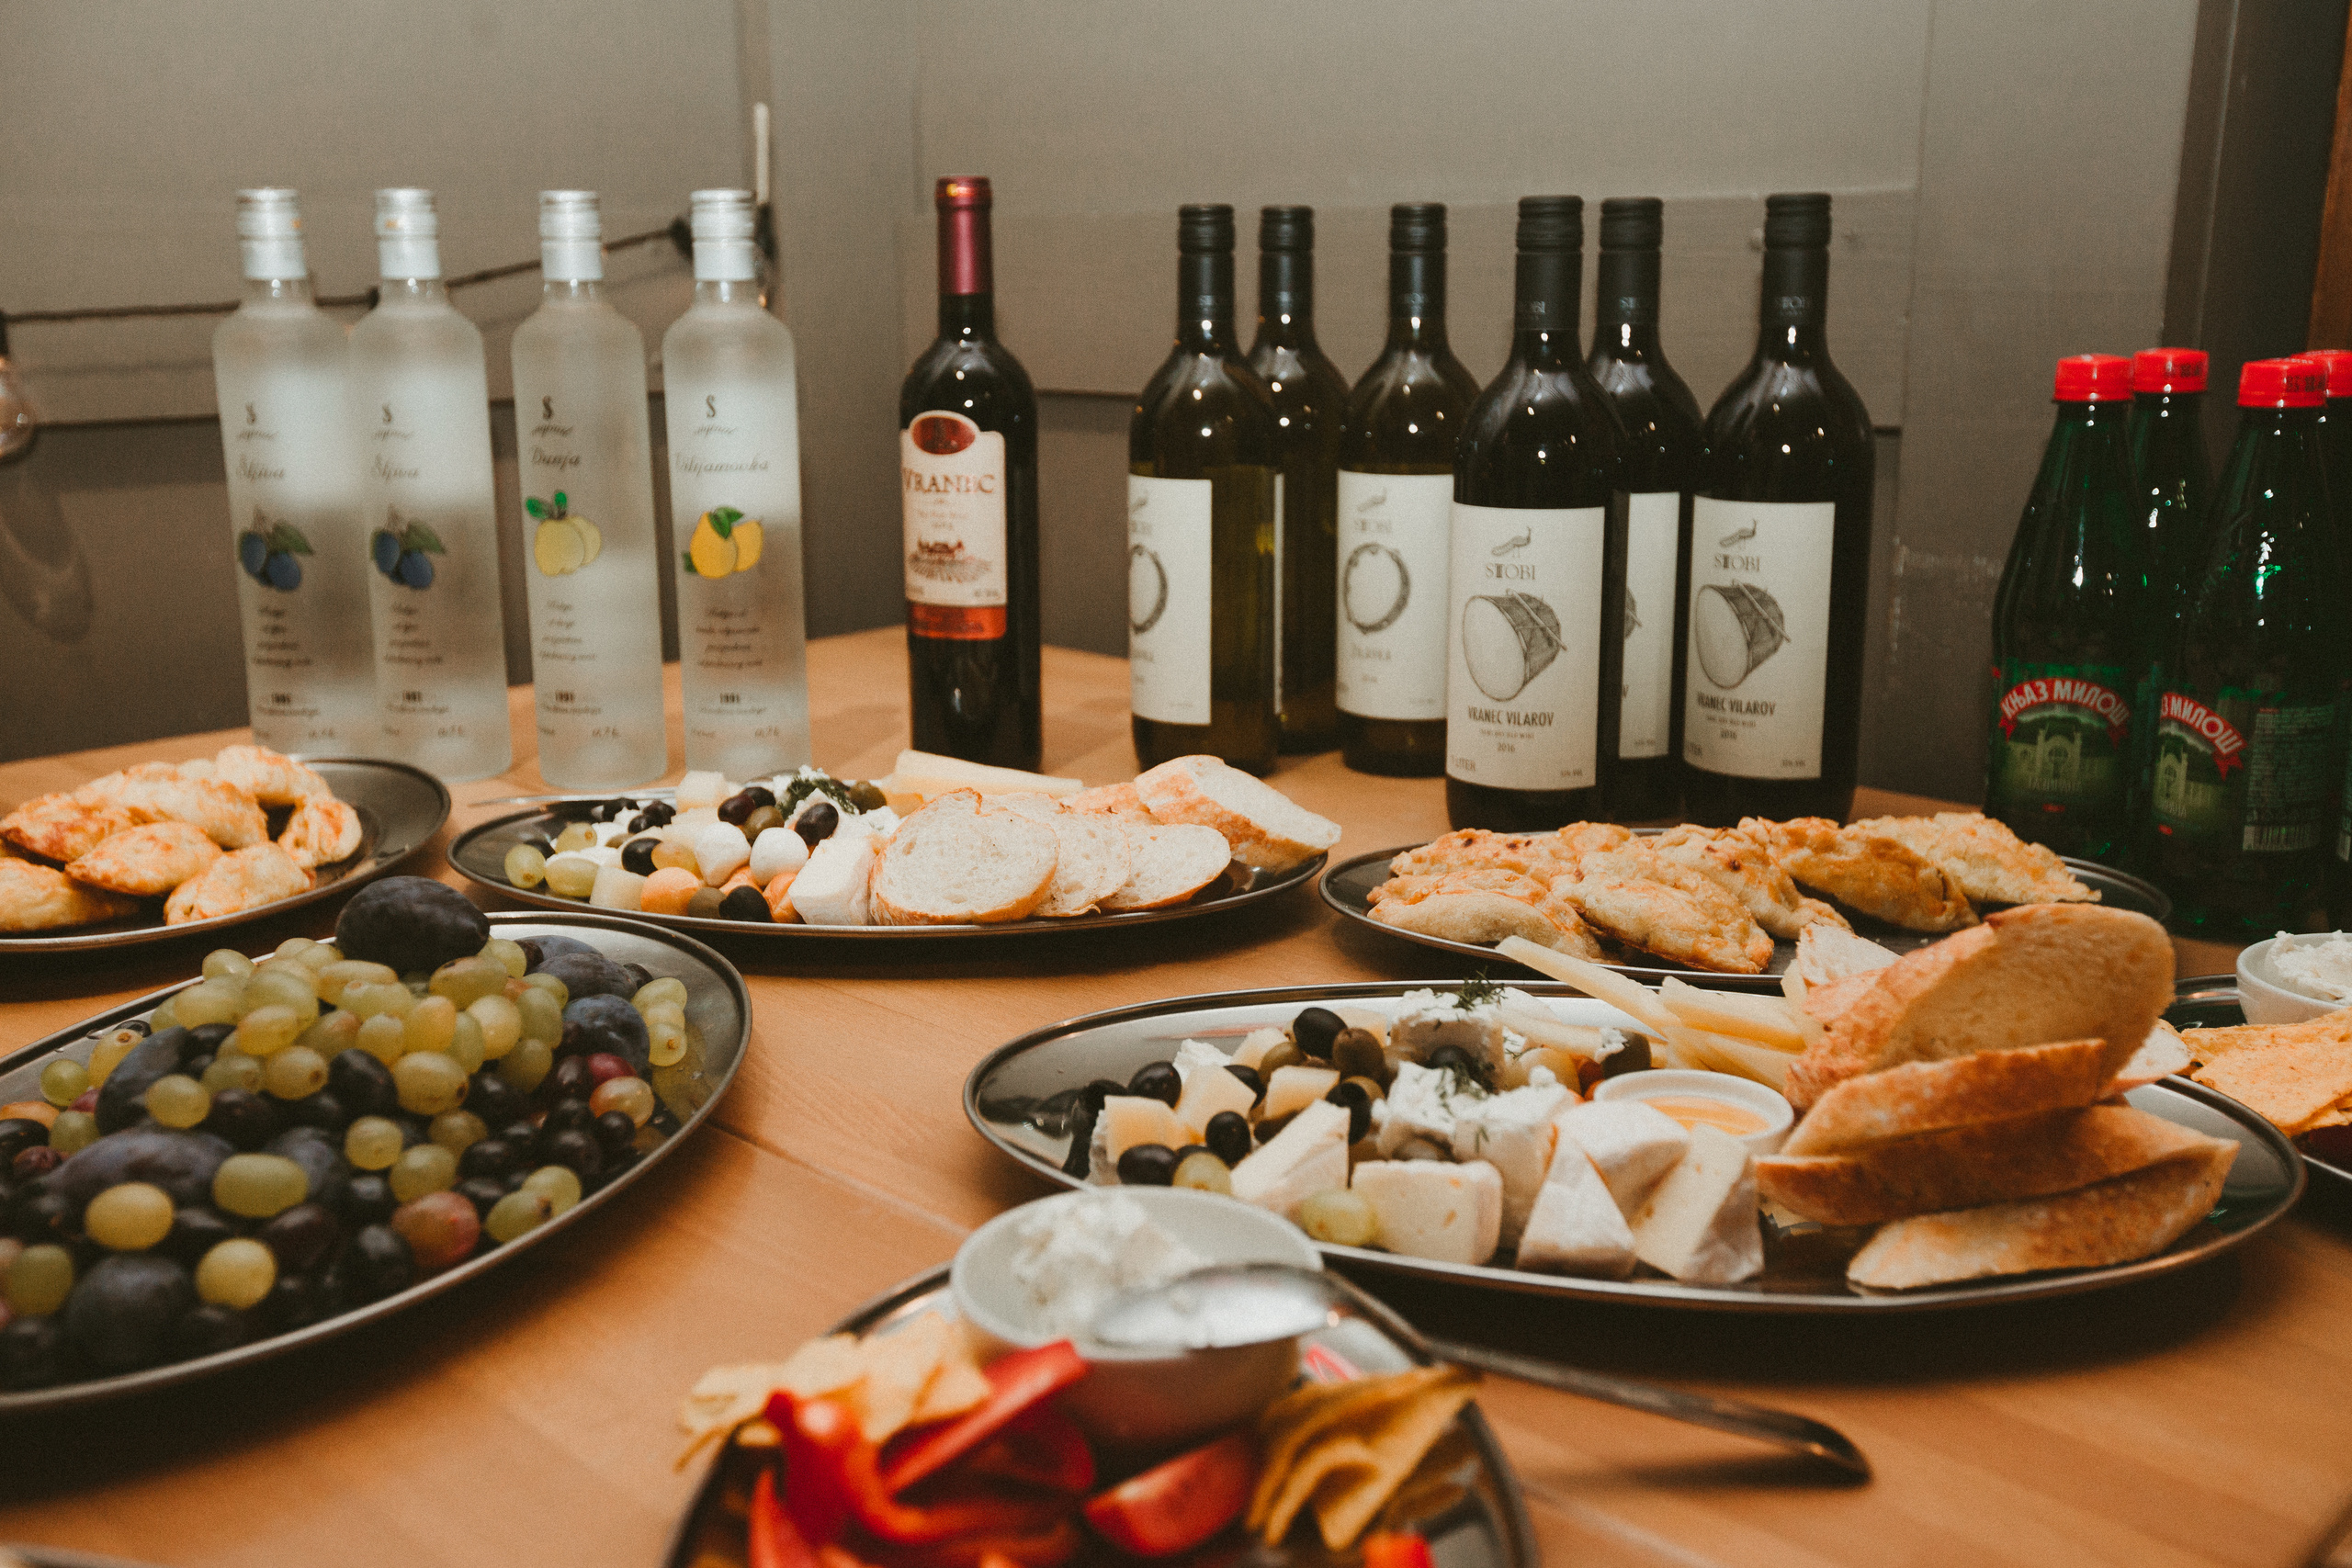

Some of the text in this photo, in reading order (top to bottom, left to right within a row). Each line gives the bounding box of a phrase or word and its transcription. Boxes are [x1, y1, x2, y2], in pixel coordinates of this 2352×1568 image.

[706, 395, 717, 419] S
[1485, 562, 1536, 581] STOBI
[1713, 553, 1762, 573] STOBI
[1730, 699, 1777, 716] VILAROV
[2001, 681, 2050, 720] КЊАЗ
[2053, 680, 2131, 727] МИЛОШ
[1468, 705, 1555, 727] VRANEC VILAROV
[2169, 694, 2245, 755] МИЛОШ
[1497, 742, 1516, 753] 2016
